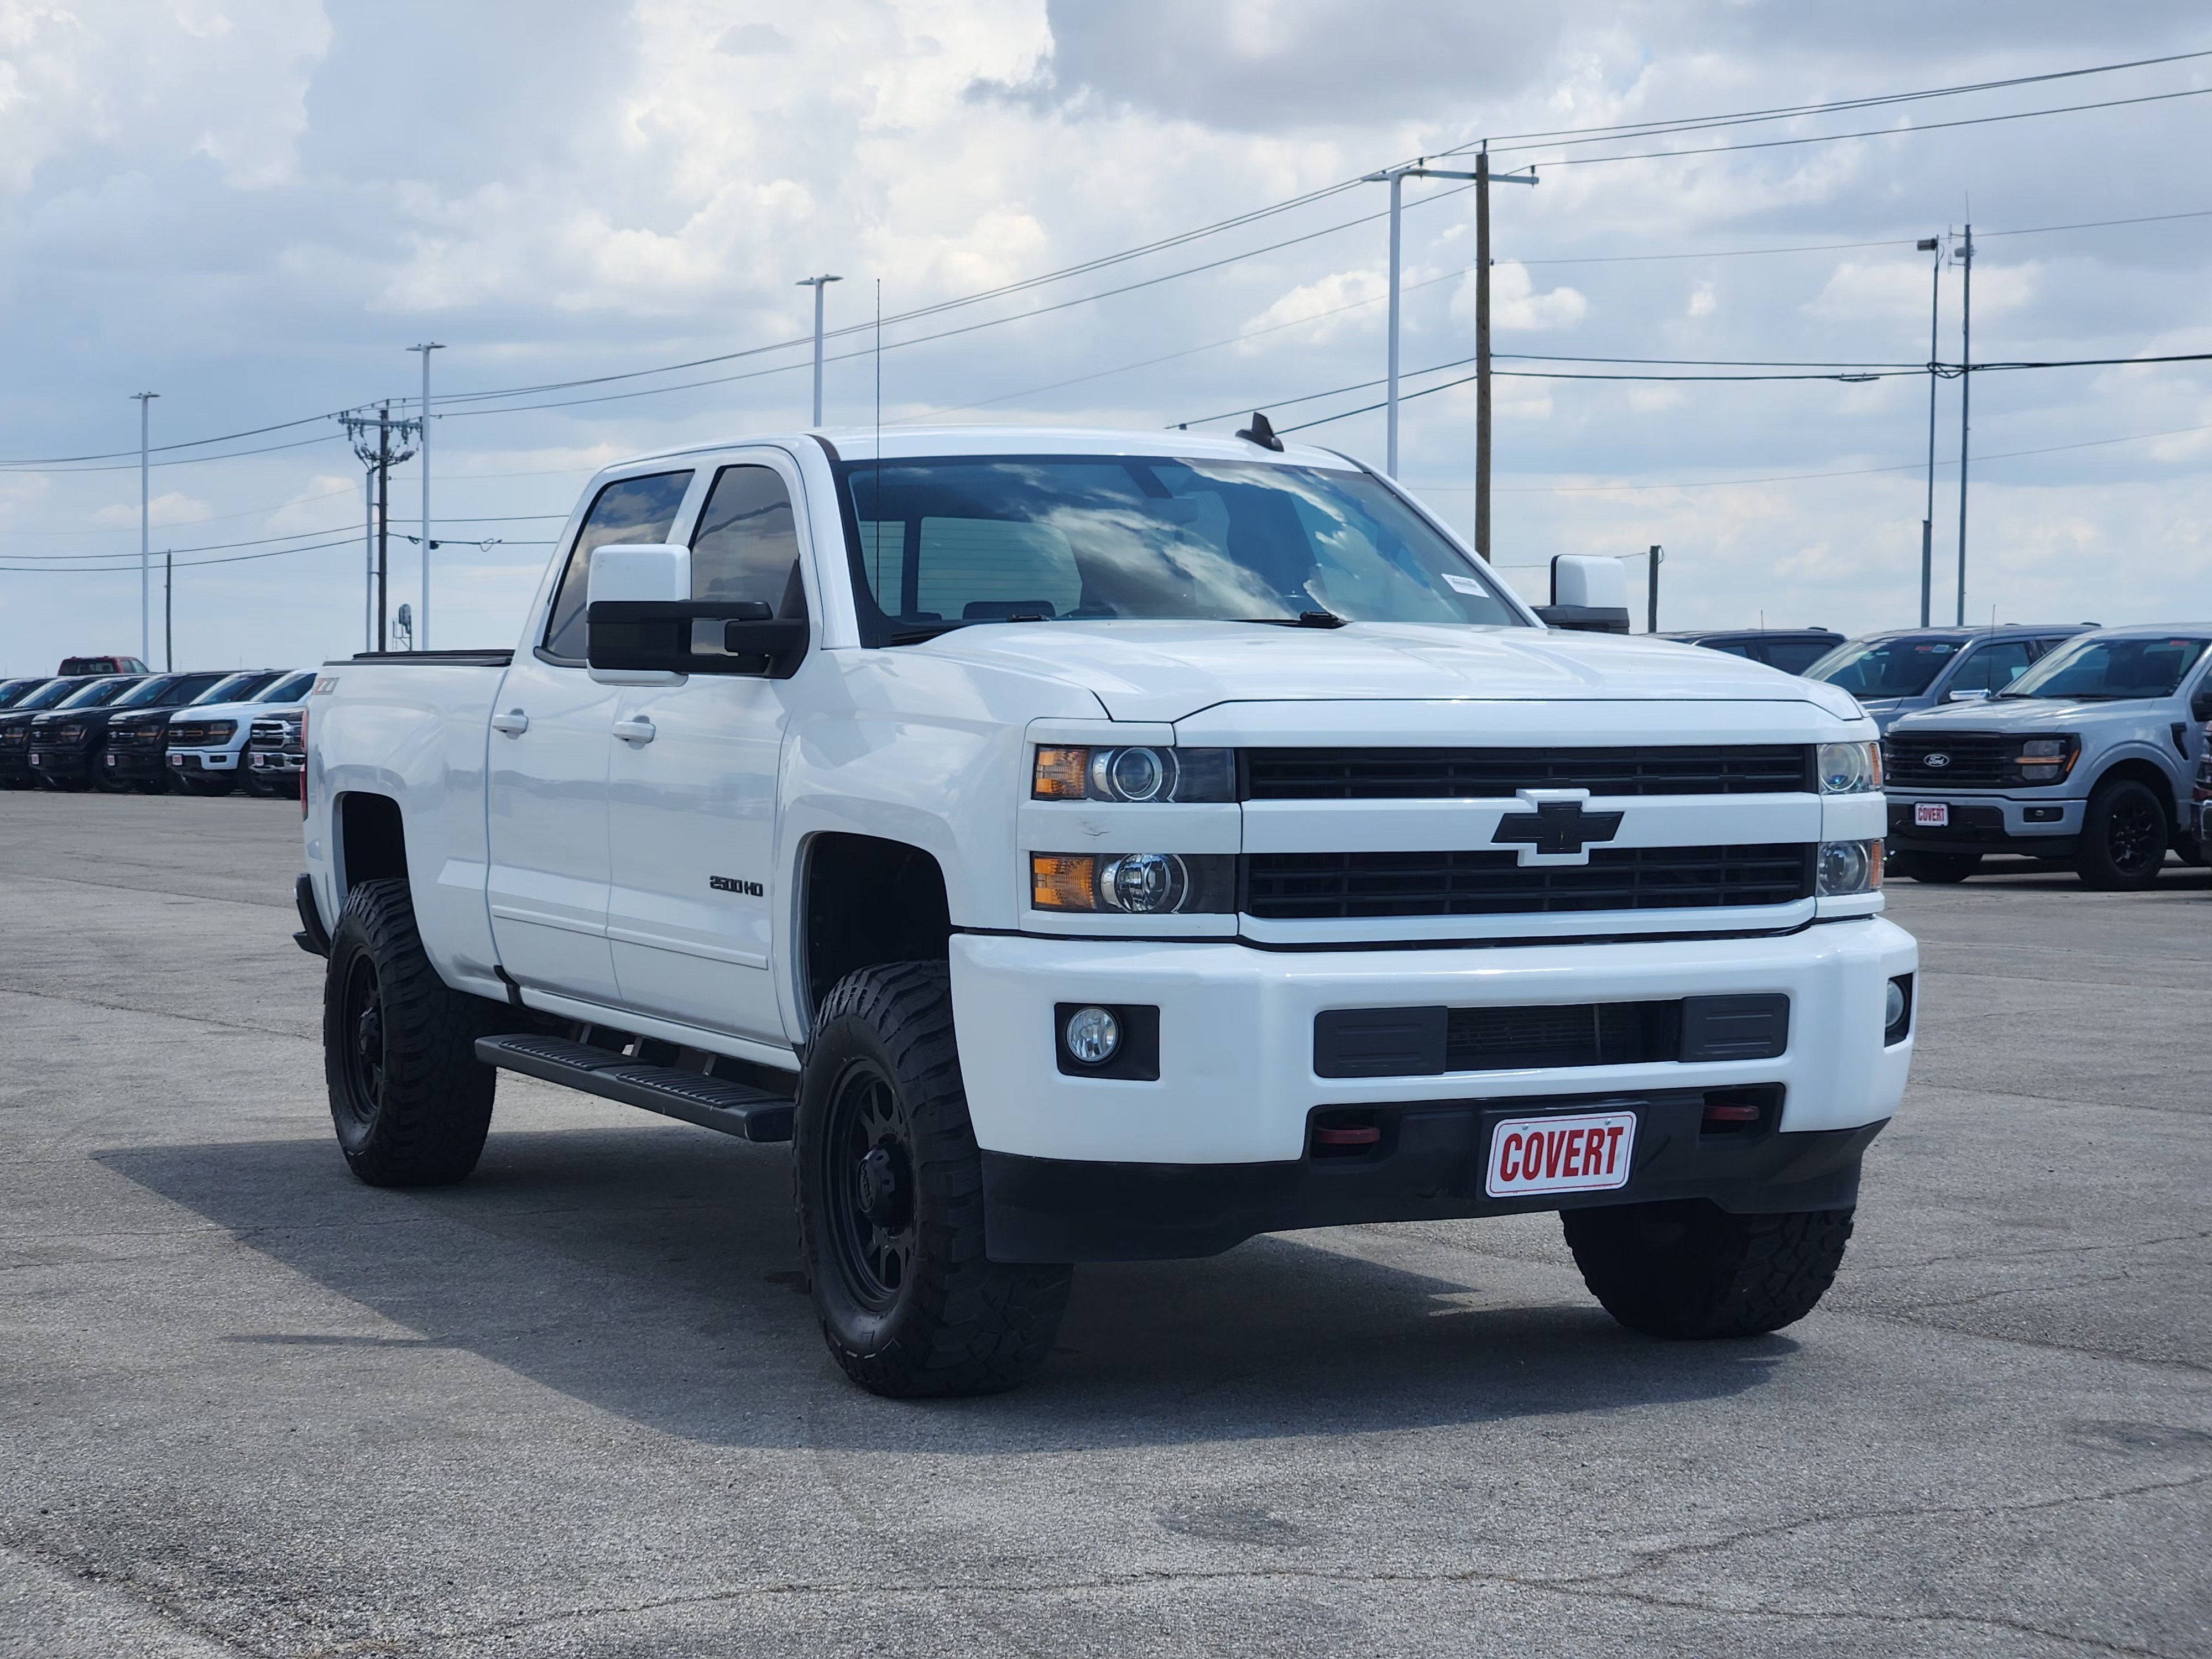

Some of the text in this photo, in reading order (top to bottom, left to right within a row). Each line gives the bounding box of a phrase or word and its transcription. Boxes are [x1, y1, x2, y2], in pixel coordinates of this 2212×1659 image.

[1918, 807, 1944, 821] COVERT
[709, 875, 763, 897] 2500 HD
[1499, 1126, 1624, 1182] COVERT
